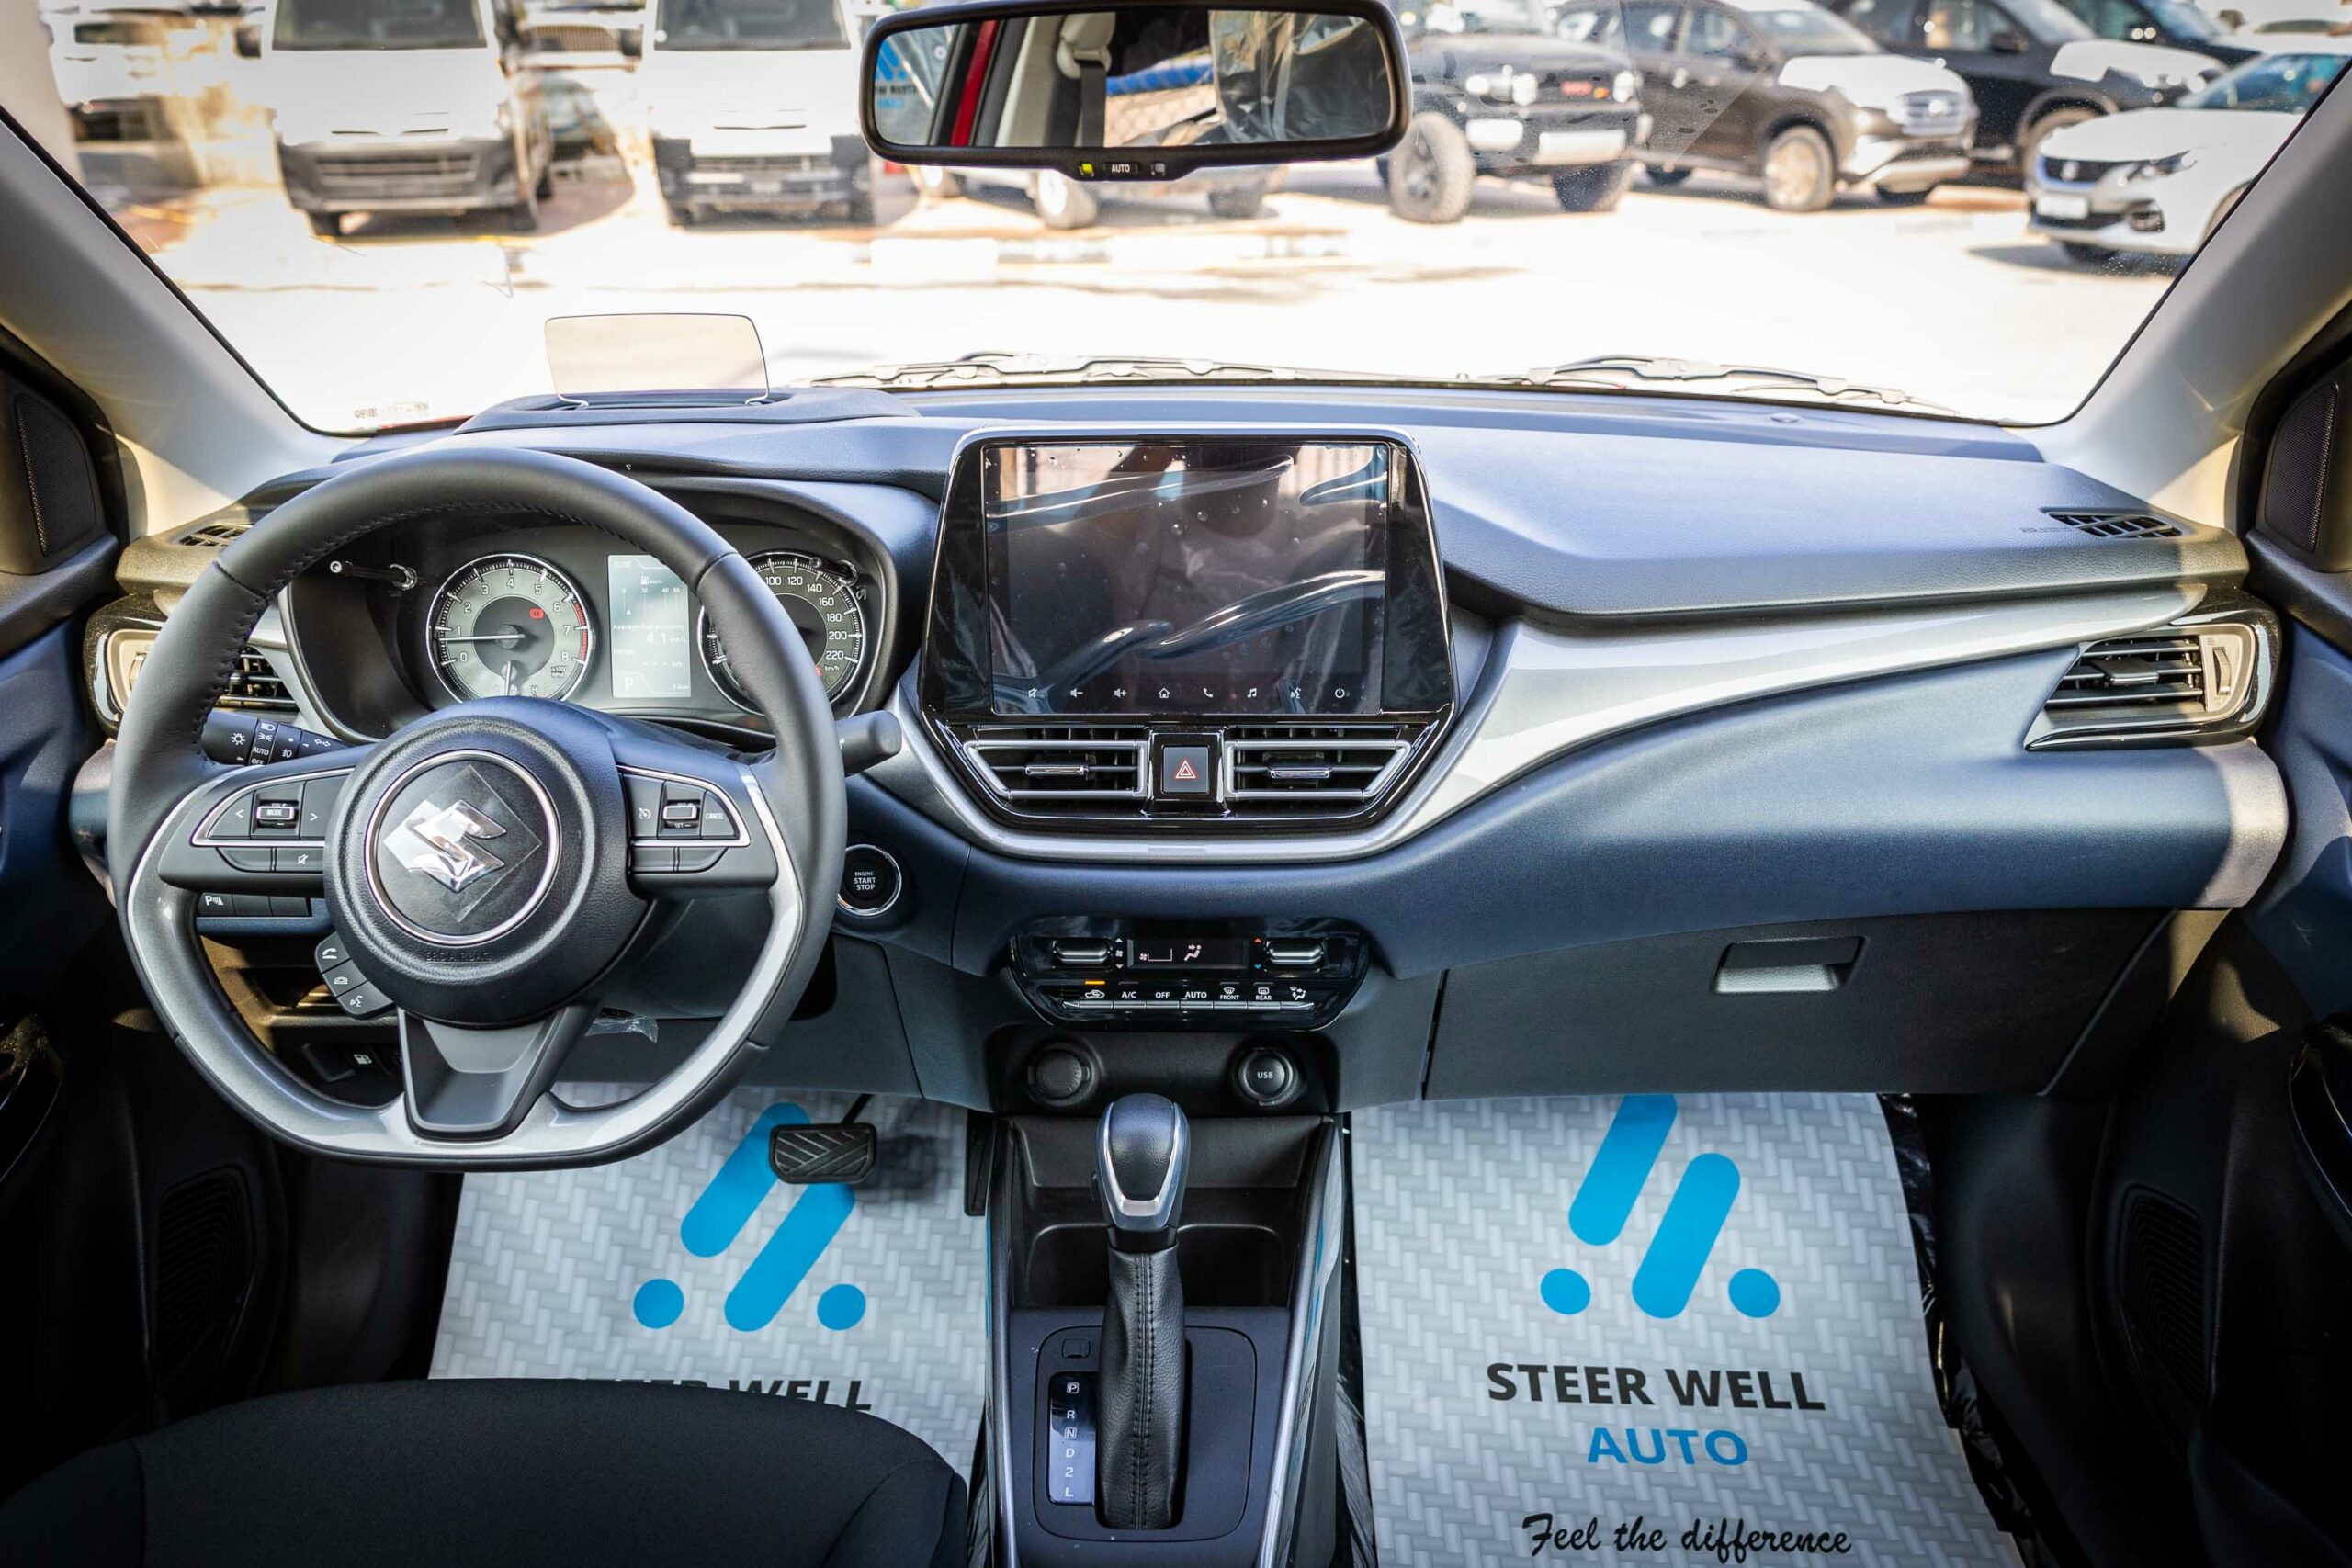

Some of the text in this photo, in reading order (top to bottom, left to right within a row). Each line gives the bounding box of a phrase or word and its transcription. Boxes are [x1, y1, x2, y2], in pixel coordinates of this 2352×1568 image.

[1111, 164, 1131, 173] AUTO
[507, 578, 514, 589] 4
[765, 576, 782, 586] 100
[787, 576, 804, 586] 120
[481, 585, 489, 595] 3
[534, 585, 542, 595] 5
[807, 583, 823, 593] 140
[819, 597, 835, 606] 160
[464, 603, 472, 613] 2
[553, 602, 561, 612] 6
[826, 613, 842, 623] 180
[457, 626, 461, 636] 1
[563, 626, 571, 636] 7
[829, 631, 848, 640] 200
[459, 652, 468, 662] 0
[561, 651, 569, 661] 8
[826, 650, 844, 660] 220
[253, 746, 270, 756] AUTO
[854, 876, 876, 885] START
[1257, 1070, 1274, 1079] USB
[1069, 1383, 1078, 1393] P
[1486, 1362, 1826, 1411] STEER WELL
[1067, 1410, 1076, 1419] R
[1066, 1428, 1075, 1438] N
[1587, 1427, 1748, 1466] AUTO
[1065, 1449, 1075, 1458] D
[1065, 1467, 1074, 1478] 2
[1065, 1487, 1074, 1497] L
[1522, 1512, 1852, 1564] Feel the difference
